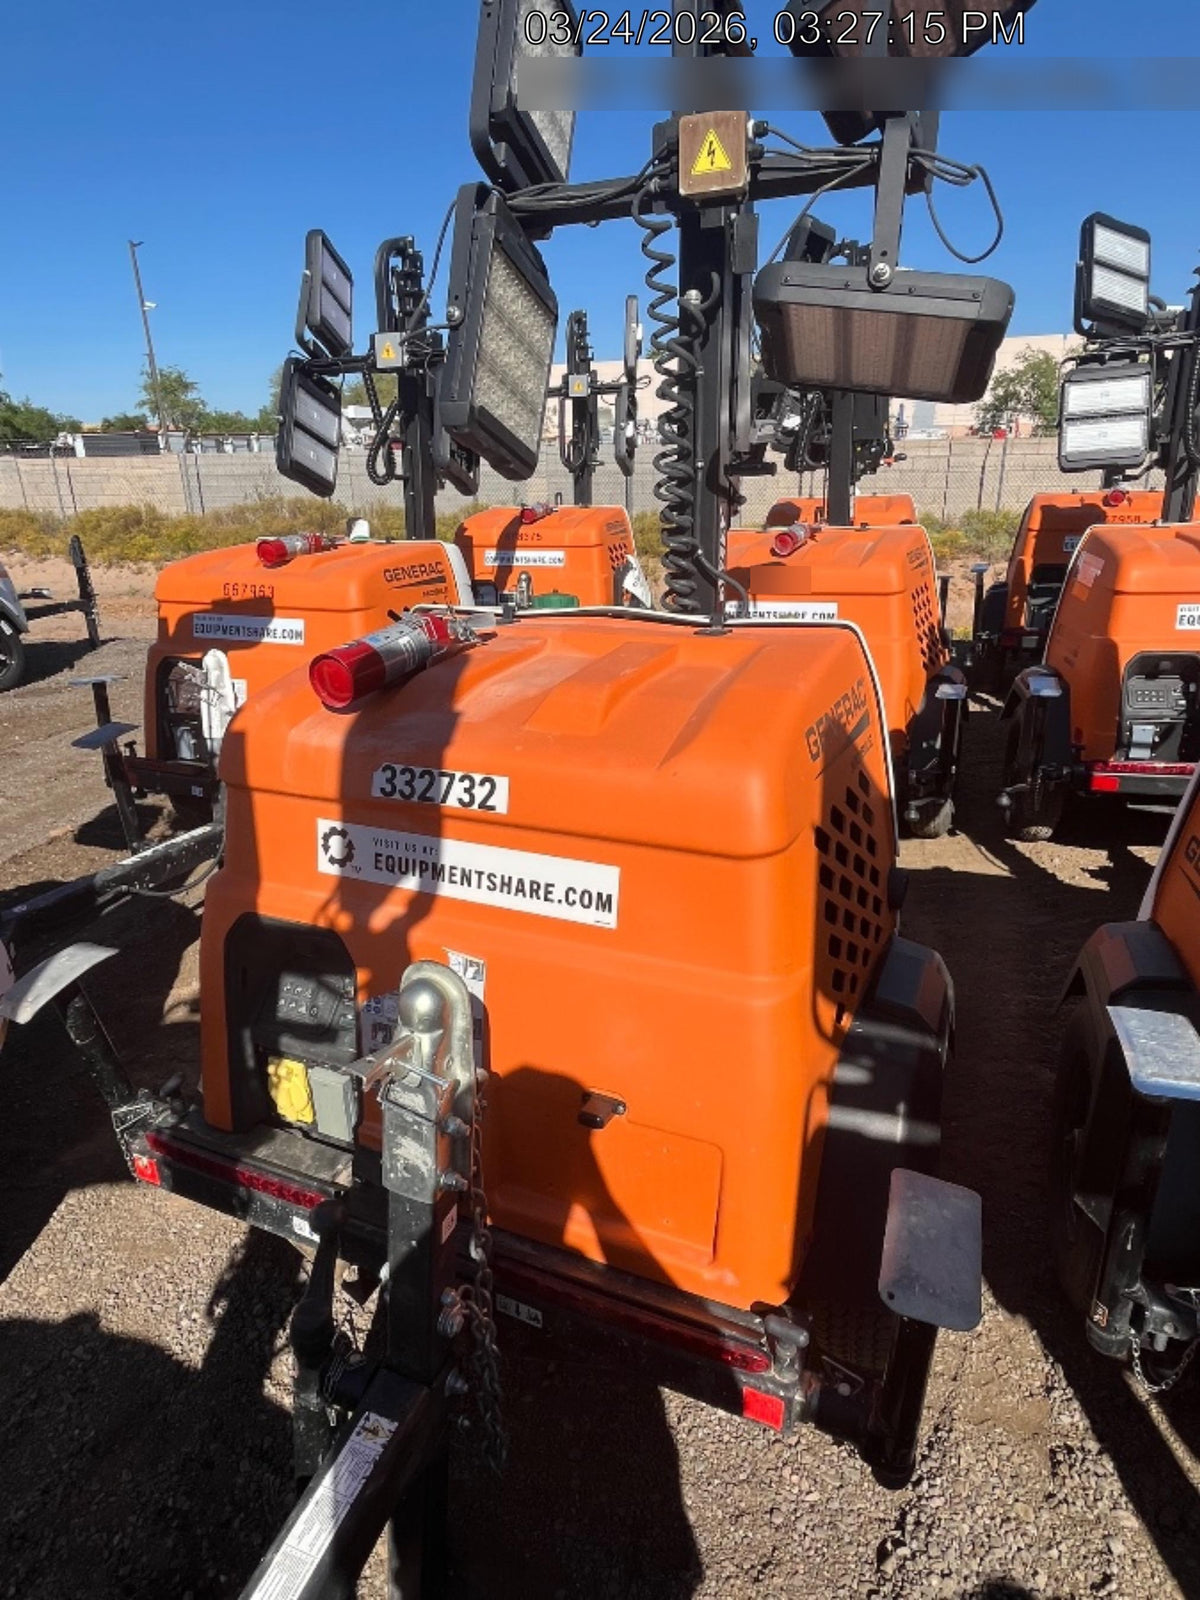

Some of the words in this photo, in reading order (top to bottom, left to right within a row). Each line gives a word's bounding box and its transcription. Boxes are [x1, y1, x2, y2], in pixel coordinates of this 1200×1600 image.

[383, 561, 444, 582] GENERAC
[194, 623, 302, 640] EQUIPMENTSHARE.COM
[805, 677, 867, 762] GENERAC
[379, 763, 497, 812] 332732
[372, 836, 399, 851] VISIT
[404, 842, 417, 853] US
[374, 851, 613, 914] EQUIPMENTSHARE.COM
